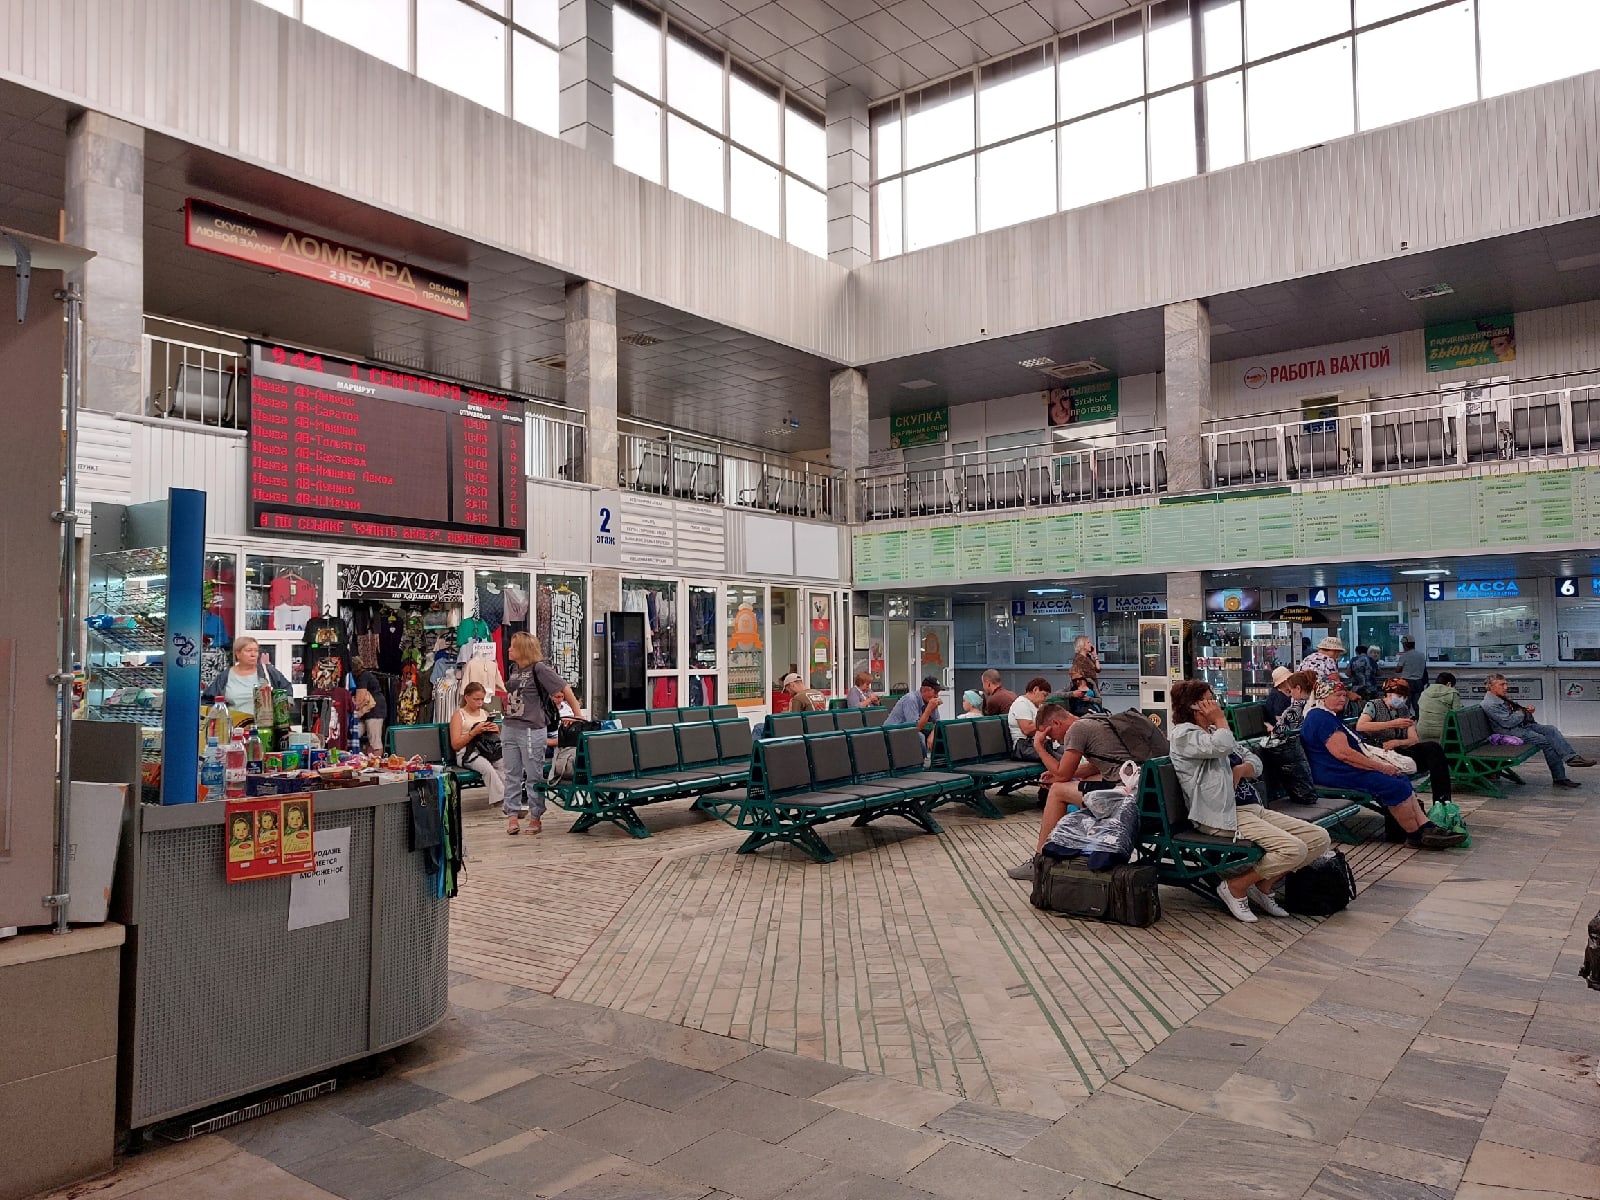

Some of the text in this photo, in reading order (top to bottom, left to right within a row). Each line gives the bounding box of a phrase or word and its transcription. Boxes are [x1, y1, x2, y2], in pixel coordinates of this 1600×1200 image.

[214, 218, 258, 239] СКУПКА
[195, 226, 275, 255] ЛЮБОЙ ЗАЛОГ
[280, 232, 416, 288] ЛОМБАРД
[328, 270, 372, 290] 2 ЭТАЖ
[428, 281, 460, 298] ОБМЕН
[422, 290, 465, 310] ПРОДАЖА
[1270, 346, 1390, 383] РАБОТА ВАХТОЙ
[252, 377, 288, 394] Пенза
[336, 381, 376, 395] МАРШРУТ
[350, 363, 359, 381] 1
[368, 367, 461, 402] СЕНТЯБРЯ
[467, 389, 509, 412] 2022
[252, 393, 288, 409] Пенза
[1074, 394, 1108, 406] ЗУБНЫХ
[252, 408, 288, 425] Пенза
[1070, 403, 1112, 416] ПРОТЕЗОВ
[895, 411, 943, 428] СКУПКА
[252, 424, 288, 441] Пенза
[252, 440, 288, 456] Пенза
[252, 456, 288, 472] Пенза
[252, 472, 288, 487] Пенза
[252, 488, 288, 502] Пенза
[298, 518, 345, 533] ССЫЛКЕ
[599, 507, 611, 533] 2
[359, 570, 440, 593] ОДЕЖДА
[1428, 584, 1441, 600] 5
[1456, 580, 1519, 593] КАССА
[1560, 579, 1575, 596] 6
[1314, 589, 1326, 604] 4
[1337, 586, 1392, 598] КАССА
[1015, 601, 1022, 614] 1
[1032, 600, 1073, 609] КАССА
[1097, 599, 1105, 611] 2
[1115, 597, 1159, 607] КАССА
[314, 847, 342, 858] РОДАЖЕ
[300, 865, 343, 879] МОРОЖЕНОЕ
